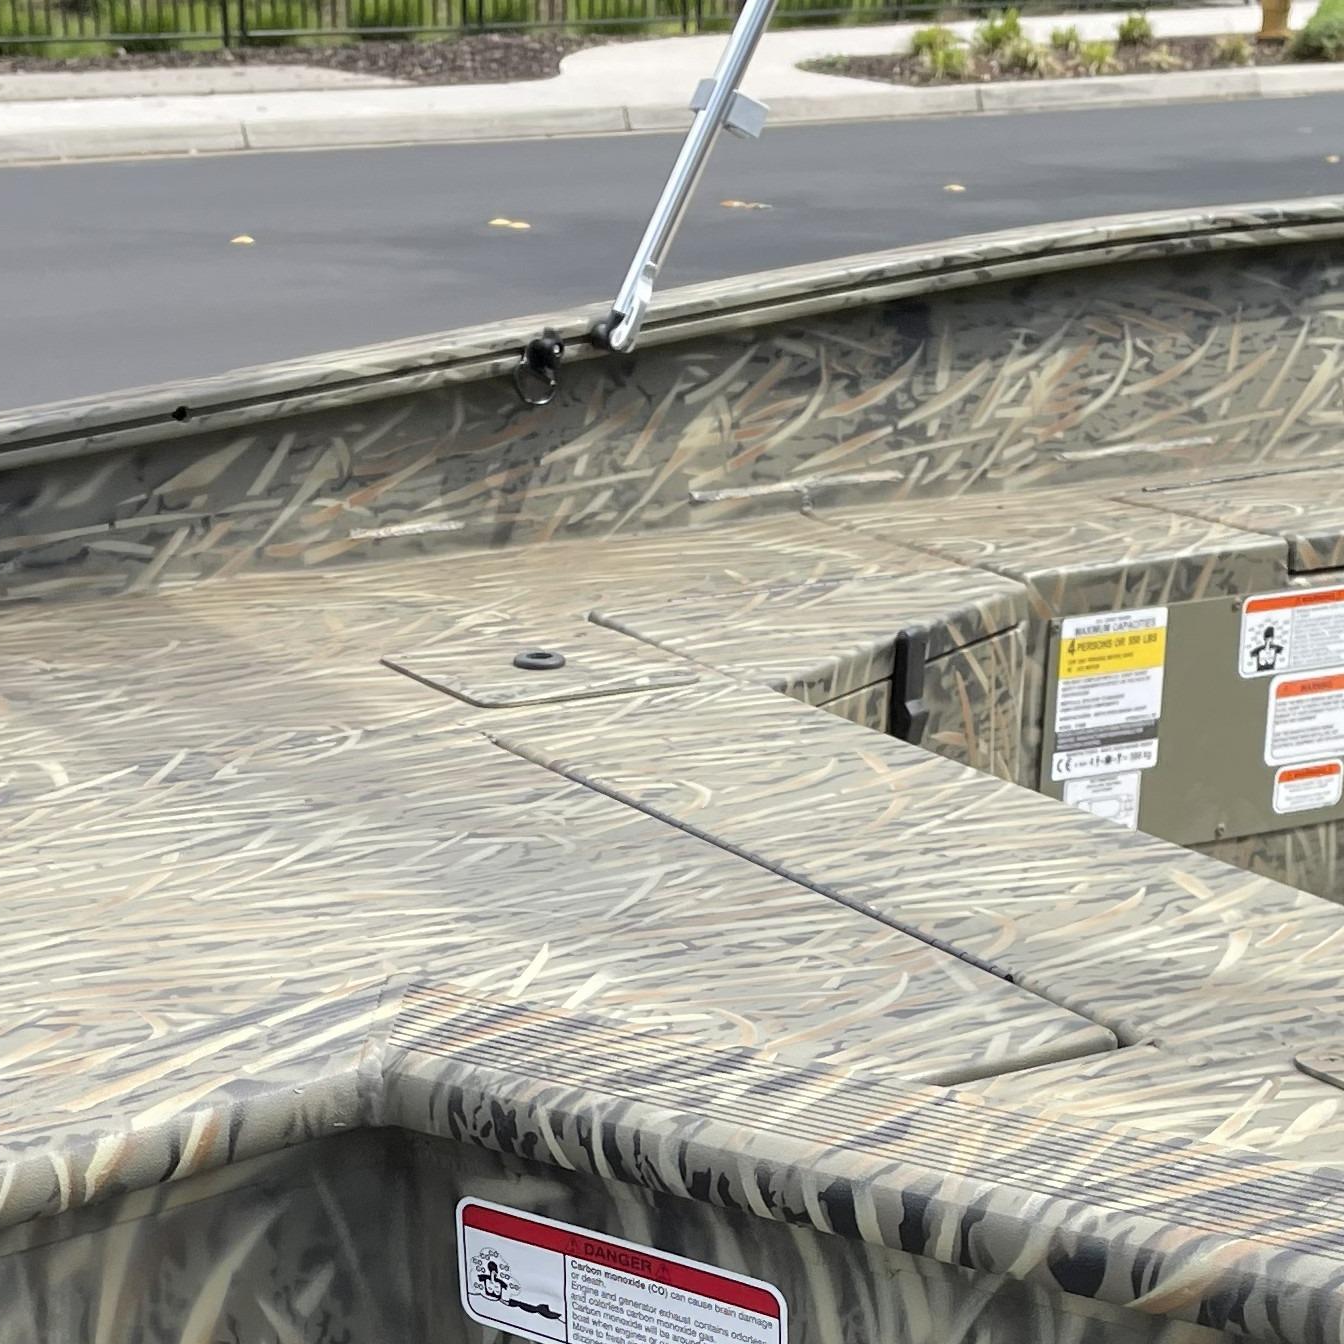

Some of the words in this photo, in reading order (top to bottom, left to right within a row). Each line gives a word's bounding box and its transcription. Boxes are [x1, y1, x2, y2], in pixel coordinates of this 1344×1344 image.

[1068, 639, 1075, 656] 4
[584, 1244, 651, 1272] DANGER
[570, 1271, 579, 1279] or
[570, 1259, 601, 1276] Carbon
[604, 1271, 645, 1289] monoxide
[648, 1283, 668, 1298] (CO)
[670, 1292, 685, 1301] can
[687, 1297, 712, 1310] cause
[714, 1303, 736, 1317] brain
[738, 1312, 772, 1329] damage
[571, 1280, 598, 1296] Engine
[600, 1291, 616, 1301] and
[618, 1296, 656, 1314] generator
[658, 1308, 690, 1324] exhaust
[693, 1319, 728, 1336] contains
[570, 1292, 586, 1303] and
[588, 1297, 624, 1314] colorless
[625, 1309, 654, 1322] carbon
[656, 1318, 696, 1337] monoxide
[571, 1301, 601, 1317] Carbon
[602, 1312, 642, 1330] monoxide
[644, 1325, 657, 1335] will
[659, 1328, 669, 1339] be
[572, 1311, 589, 1324] boat
[591, 1318, 613, 1331] when
[614, 1326, 646, 1342] engines
[648, 1336, 657, 1344] or
[572, 1322, 593, 1334] Move
[595, 1329, 603, 1338] to
[605, 1332, 625, 1344] fresh
